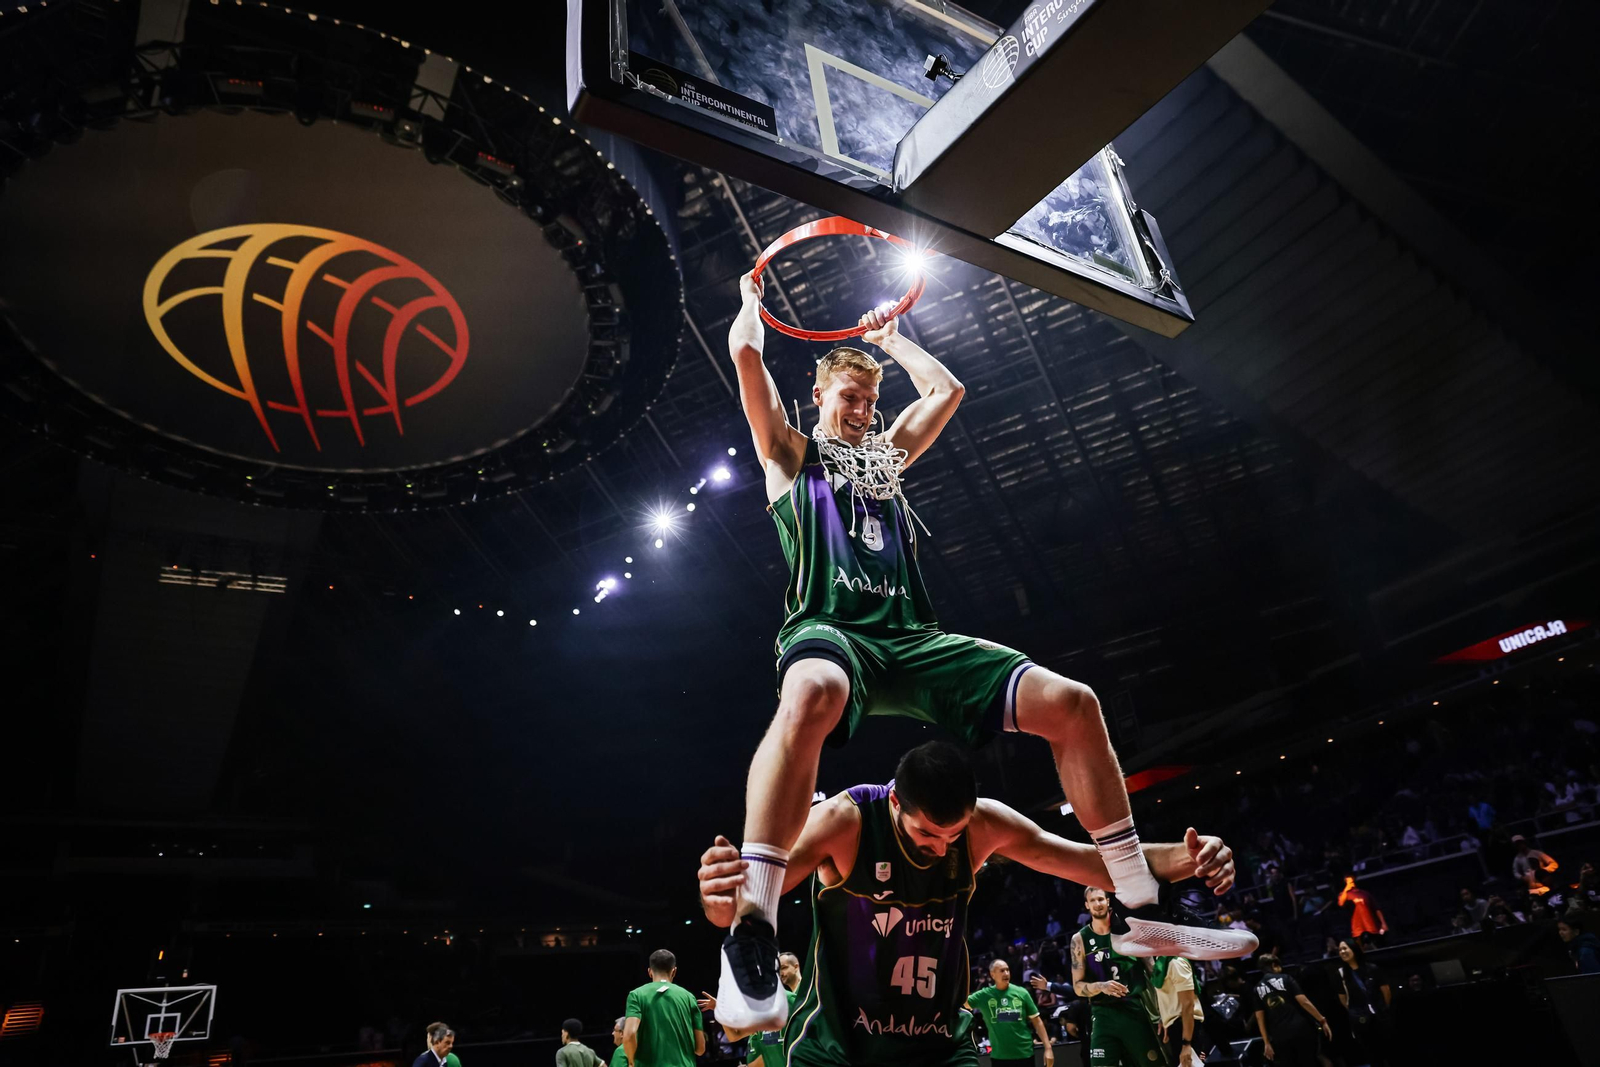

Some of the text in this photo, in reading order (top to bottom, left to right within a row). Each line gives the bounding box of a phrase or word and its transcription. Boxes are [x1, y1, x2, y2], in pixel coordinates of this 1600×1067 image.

[1025, 26, 1048, 57] CUP
[681, 86, 769, 128] INTERCONTINENTAL
[863, 516, 884, 551] 9
[1498, 619, 1568, 653] UNICAJA
[890, 955, 938, 999] 45
[1111, 966, 1120, 980] 2
